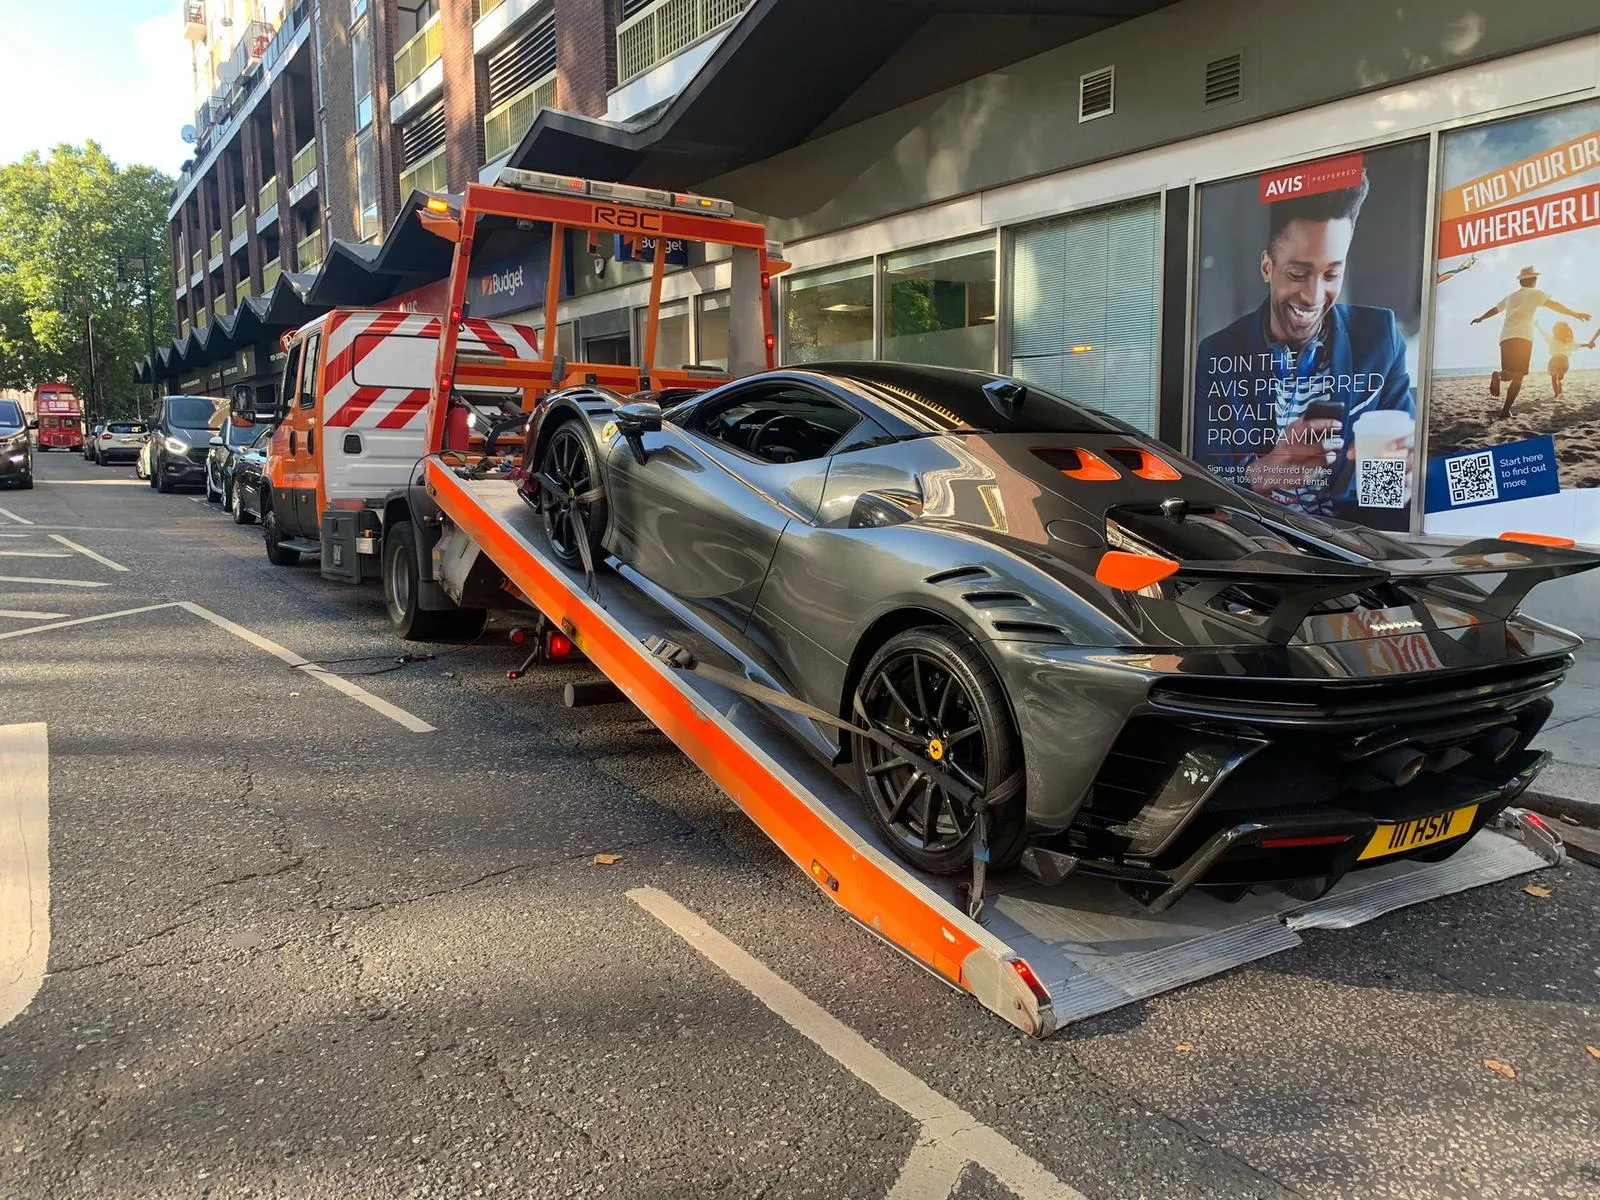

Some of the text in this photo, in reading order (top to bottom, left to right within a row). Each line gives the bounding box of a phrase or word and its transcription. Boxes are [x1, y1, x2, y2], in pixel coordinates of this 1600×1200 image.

[1265, 168, 1357, 197] AVIS PREFERRED
[1462, 136, 1600, 212] FIND YOUR DR
[1457, 197, 1577, 249] WHEREVER
[641, 237, 683, 254] Buget
[492, 265, 524, 296] Budget
[1208, 351, 1298, 375] JOIN THE
[1207, 373, 1385, 398] AVIS PREFERRED
[1208, 403, 1291, 422] LOYALTY
[1207, 427, 1343, 446] PROGRAMME
[1207, 464, 1333, 475] Sign up to Avis Preferred for free
[1500, 453, 1544, 468] Start here
[1502, 463, 1547, 478] to find out
[1236, 475, 1251, 484] 10%
[1252, 475, 1263, 484] off
[1264, 477, 1282, 486] your
[1283, 477, 1301, 486] next
[1303, 477, 1329, 487] rental.
[1503, 479, 1527, 489] more
[1411, 811, 1455, 845] HSN
